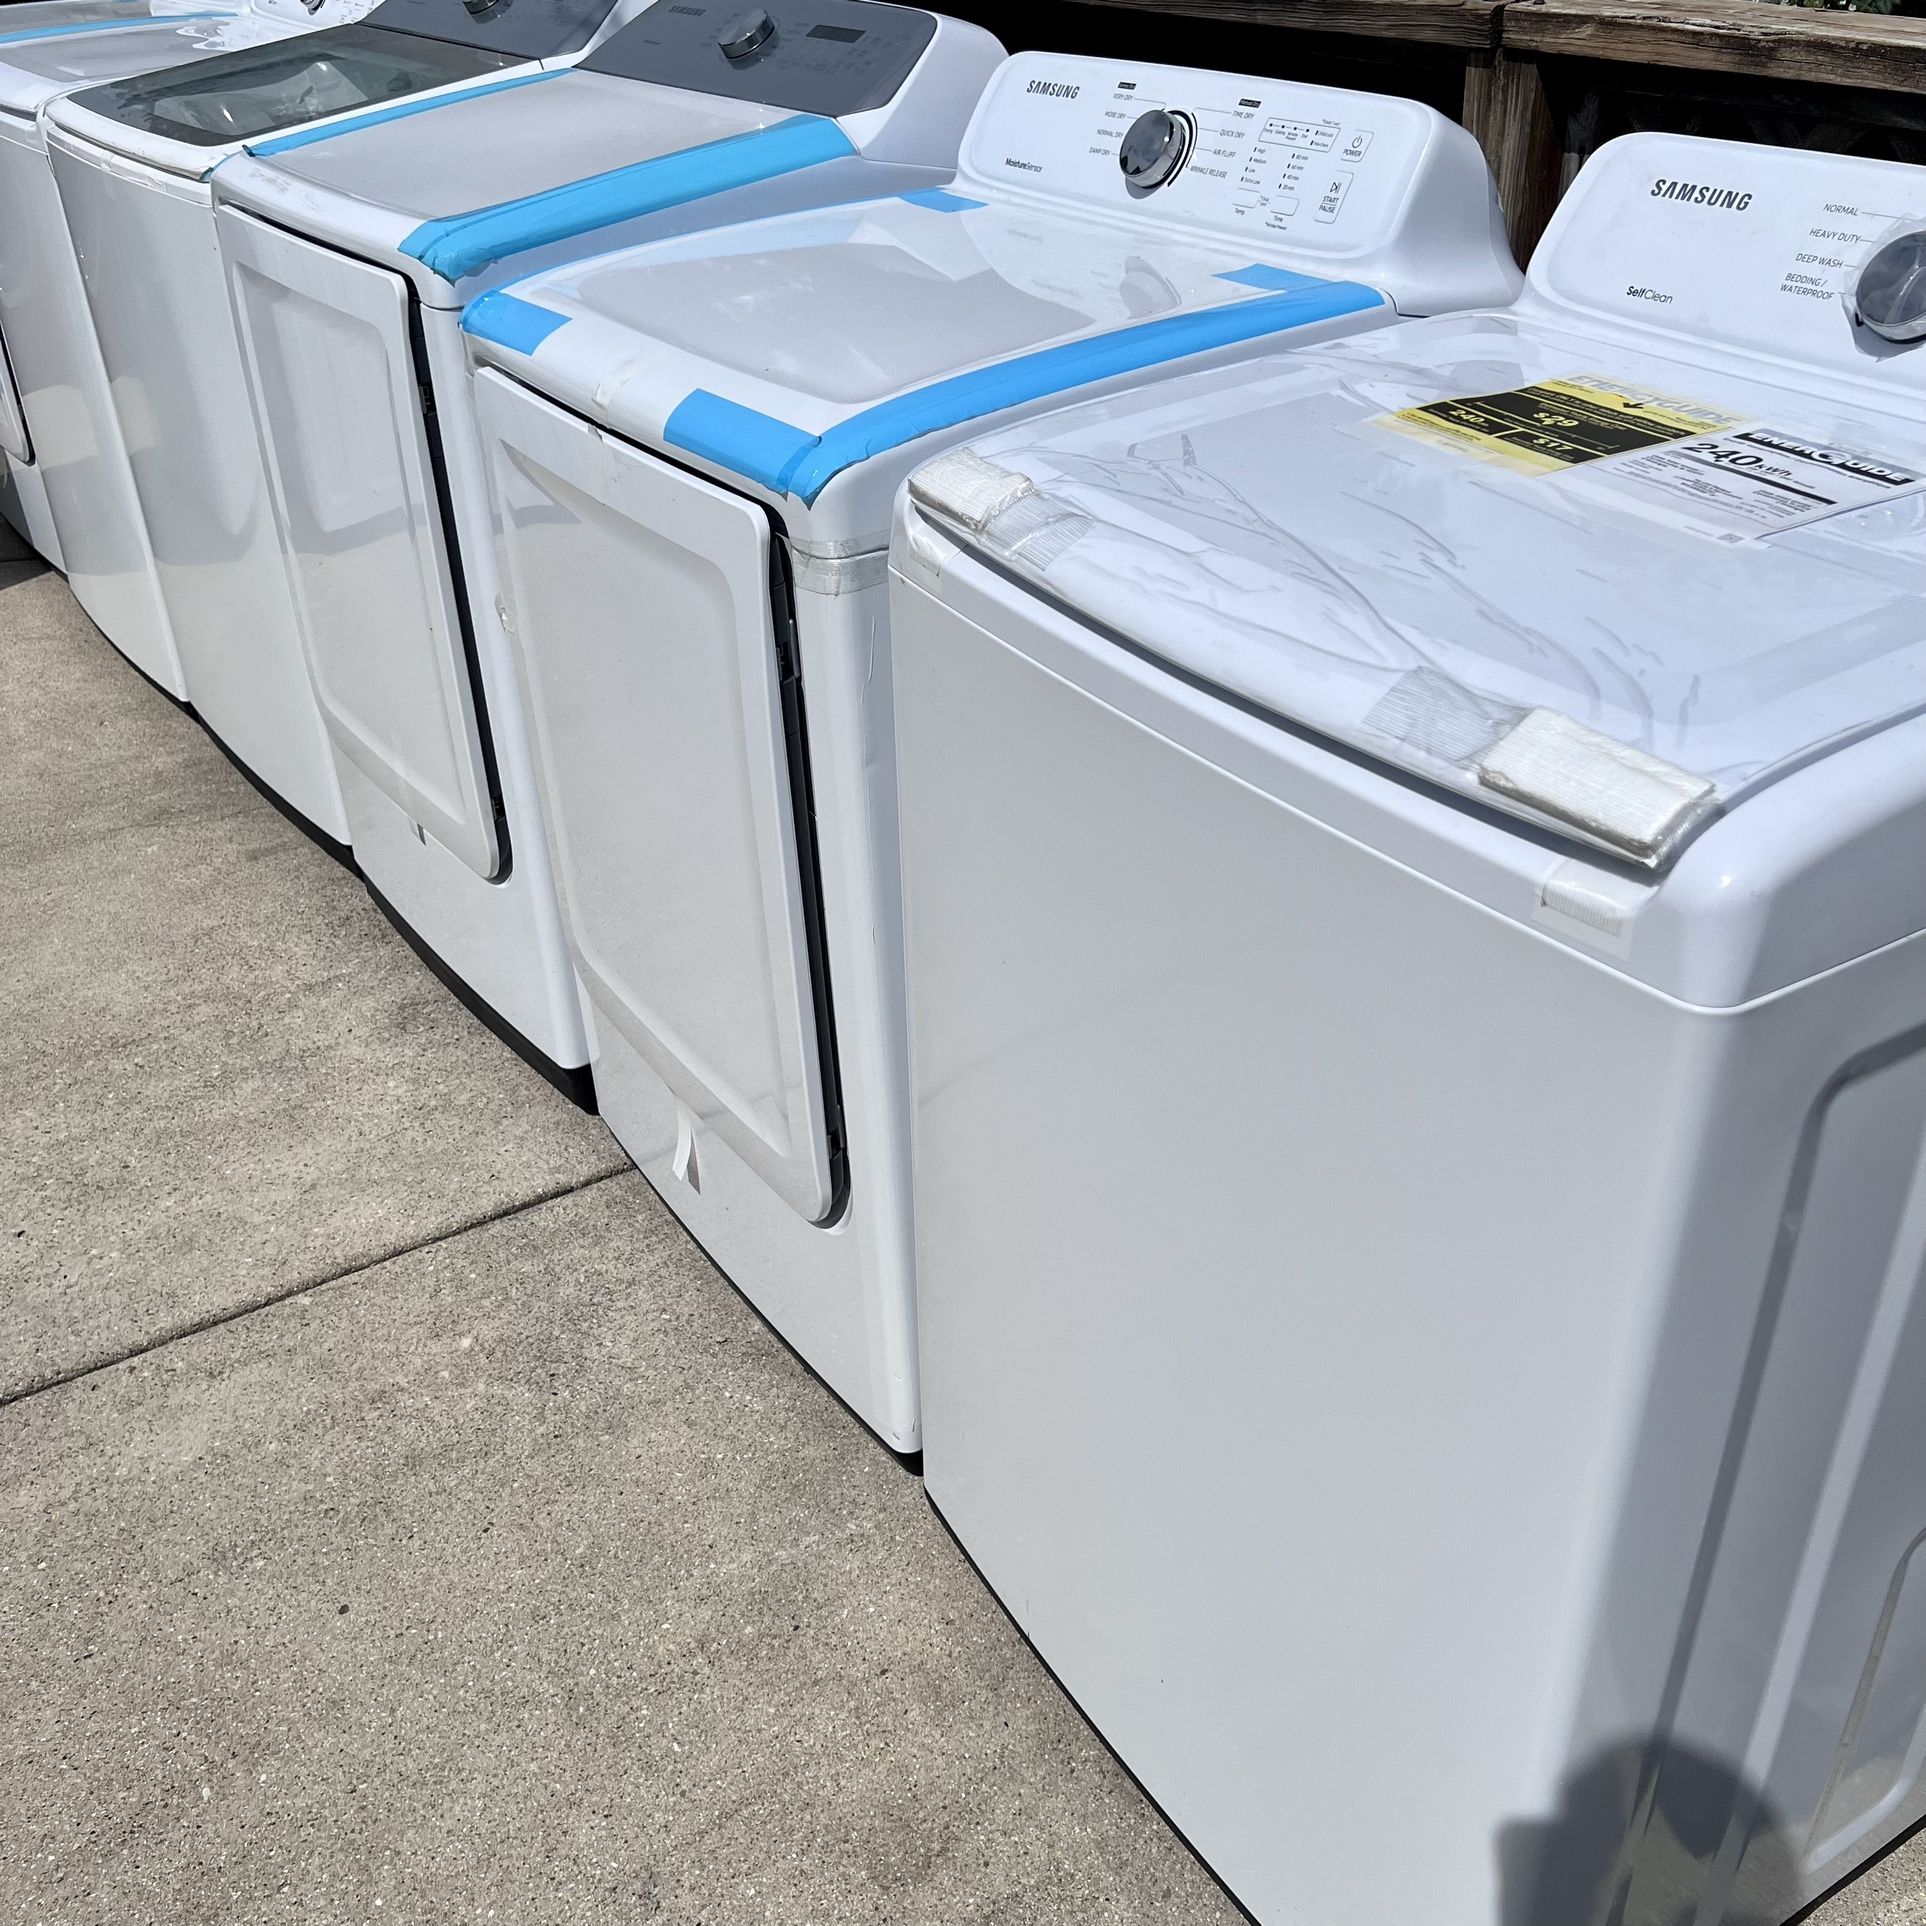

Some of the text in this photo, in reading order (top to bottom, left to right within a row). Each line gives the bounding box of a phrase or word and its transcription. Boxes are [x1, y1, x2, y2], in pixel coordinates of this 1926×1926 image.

[1027, 80, 1080, 99] SAMSUNG
[1097, 129, 1113, 137] NORMAL
[1220, 129, 1234, 137] QUICK
[1221, 150, 1236, 158] FLUFF
[1343, 149, 1362, 157] POWER
[1005, 158, 1043, 172] MoistureSensor
[1190, 165, 1227, 178] WRINKLE RELEASE
[1650, 179, 1752, 212] SAMSUNG
[1319, 204, 1336, 213] PAUSE
[1823, 203, 1858, 216] NORMAL
[1809, 228, 1861, 243] HEAVY DUTY
[1795, 253, 1843, 268] DEEP WASH
[1785, 273, 1822, 287] BEDDING
[1627, 285, 1673, 304] SelfClean
[1780, 283, 1835, 300] WATERPROOF
[1449, 409, 1486, 424] 240
[1533, 413, 1579, 427] $29
[1532, 438, 1573, 452] $17
[1681, 443, 1763, 466] 240
[1754, 464, 1792, 477] kWh
[1748, 431, 1911, 482] ENERGUIDE
